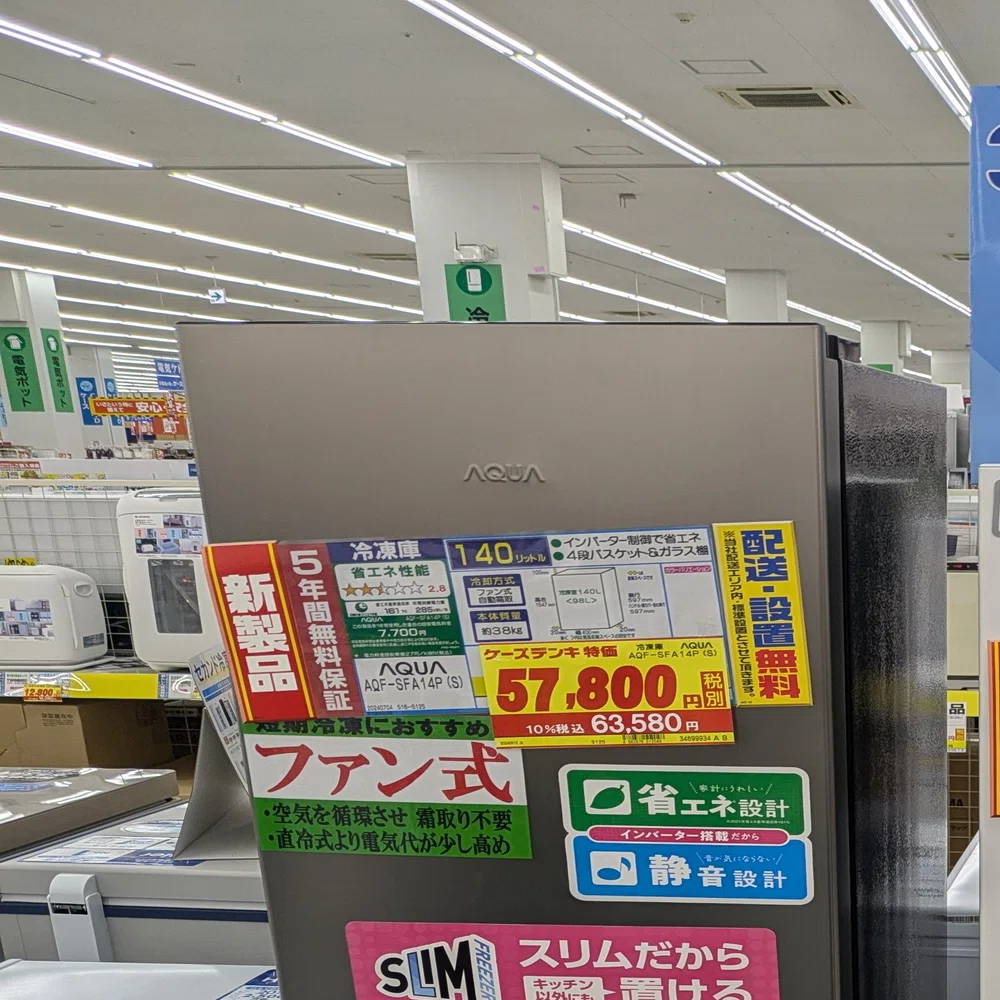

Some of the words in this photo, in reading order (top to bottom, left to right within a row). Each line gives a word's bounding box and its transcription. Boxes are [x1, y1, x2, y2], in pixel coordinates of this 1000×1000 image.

[12, 354, 32, 408] 電気ポット
[52, 356, 68, 408] 電気ポット
[464, 463, 545, 484] AQUA
[563, 533, 702, 548] インバーター制御で省エネ
[350, 540, 421, 561] 冷凍庫
[351, 564, 430, 579] 省エネ性能
[428, 585, 447, 593] 2.8
[470, 576, 515, 586] 冷却方式
[476, 588, 513, 596] ファン式
[477, 612, 522, 620] 本体質量
[740, 529, 800, 699] 配送・設置無料
[222, 573, 298, 693] 新製品
[290, 550, 353, 712] 5年間無料保証
[481, 625, 523, 636] 約38kg
[484, 647, 580, 660] ケーズデンキ
[584, 645, 618, 658] 特価
[680, 642, 713, 650] AQUA
[628, 650, 699, 660] AQF-SFA14P
[379, 660, 448, 676] AQUA
[364, 677, 443, 692] AQF-SFA14P
[704, 673, 724, 707] 税別
[255, 741, 514, 803] ファン式
[637, 782, 790, 818] 省エネ設計
[416, 809, 512, 831] 霜取り不要
[620, 829, 760, 842] インバーター搭載だから
[649, 855, 788, 888] 静音設計
[518, 938, 750, 970] スリムだから
[532, 978, 594, 991] キッチン
